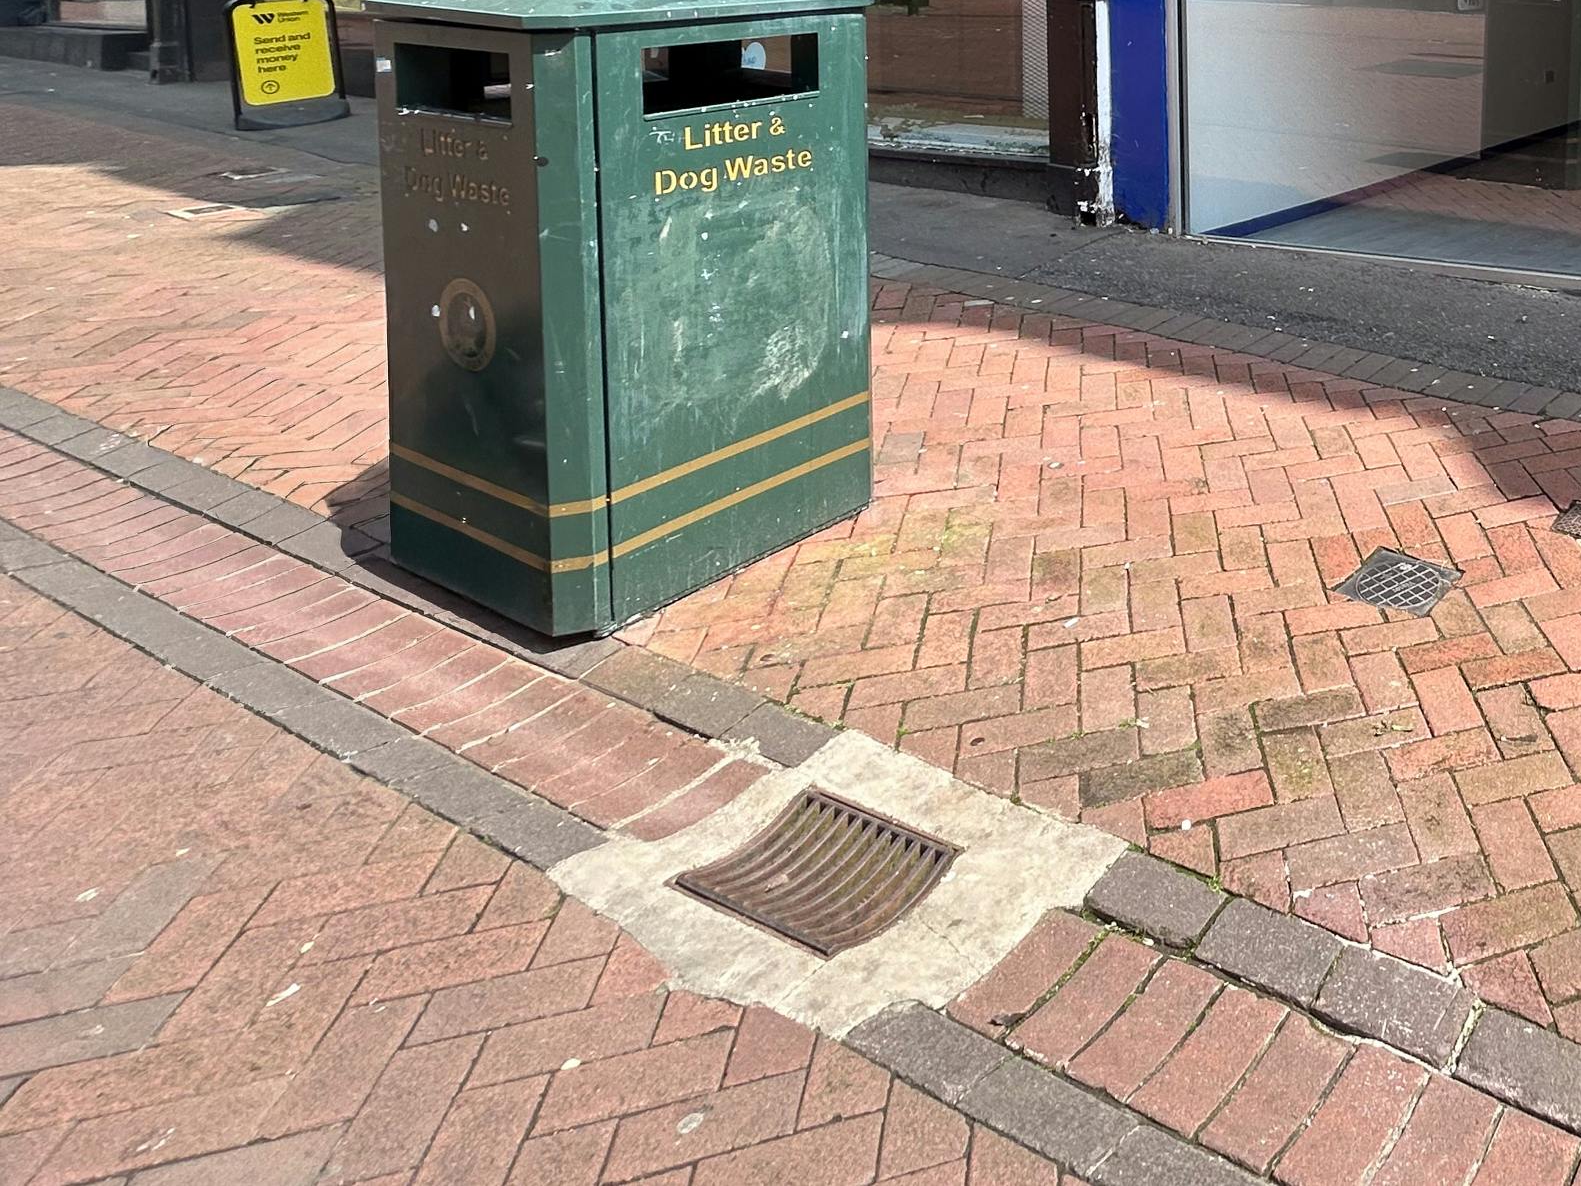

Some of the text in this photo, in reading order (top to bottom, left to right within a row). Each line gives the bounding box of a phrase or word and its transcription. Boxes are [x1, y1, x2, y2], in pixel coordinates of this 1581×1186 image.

[254, 32, 311, 45] Send and
[255, 43, 301, 55] receive
[256, 54, 299, 65] money
[257, 64, 287, 74] here
[684, 117, 786, 150] Litter &
[655, 148, 813, 196] Dog Waste
